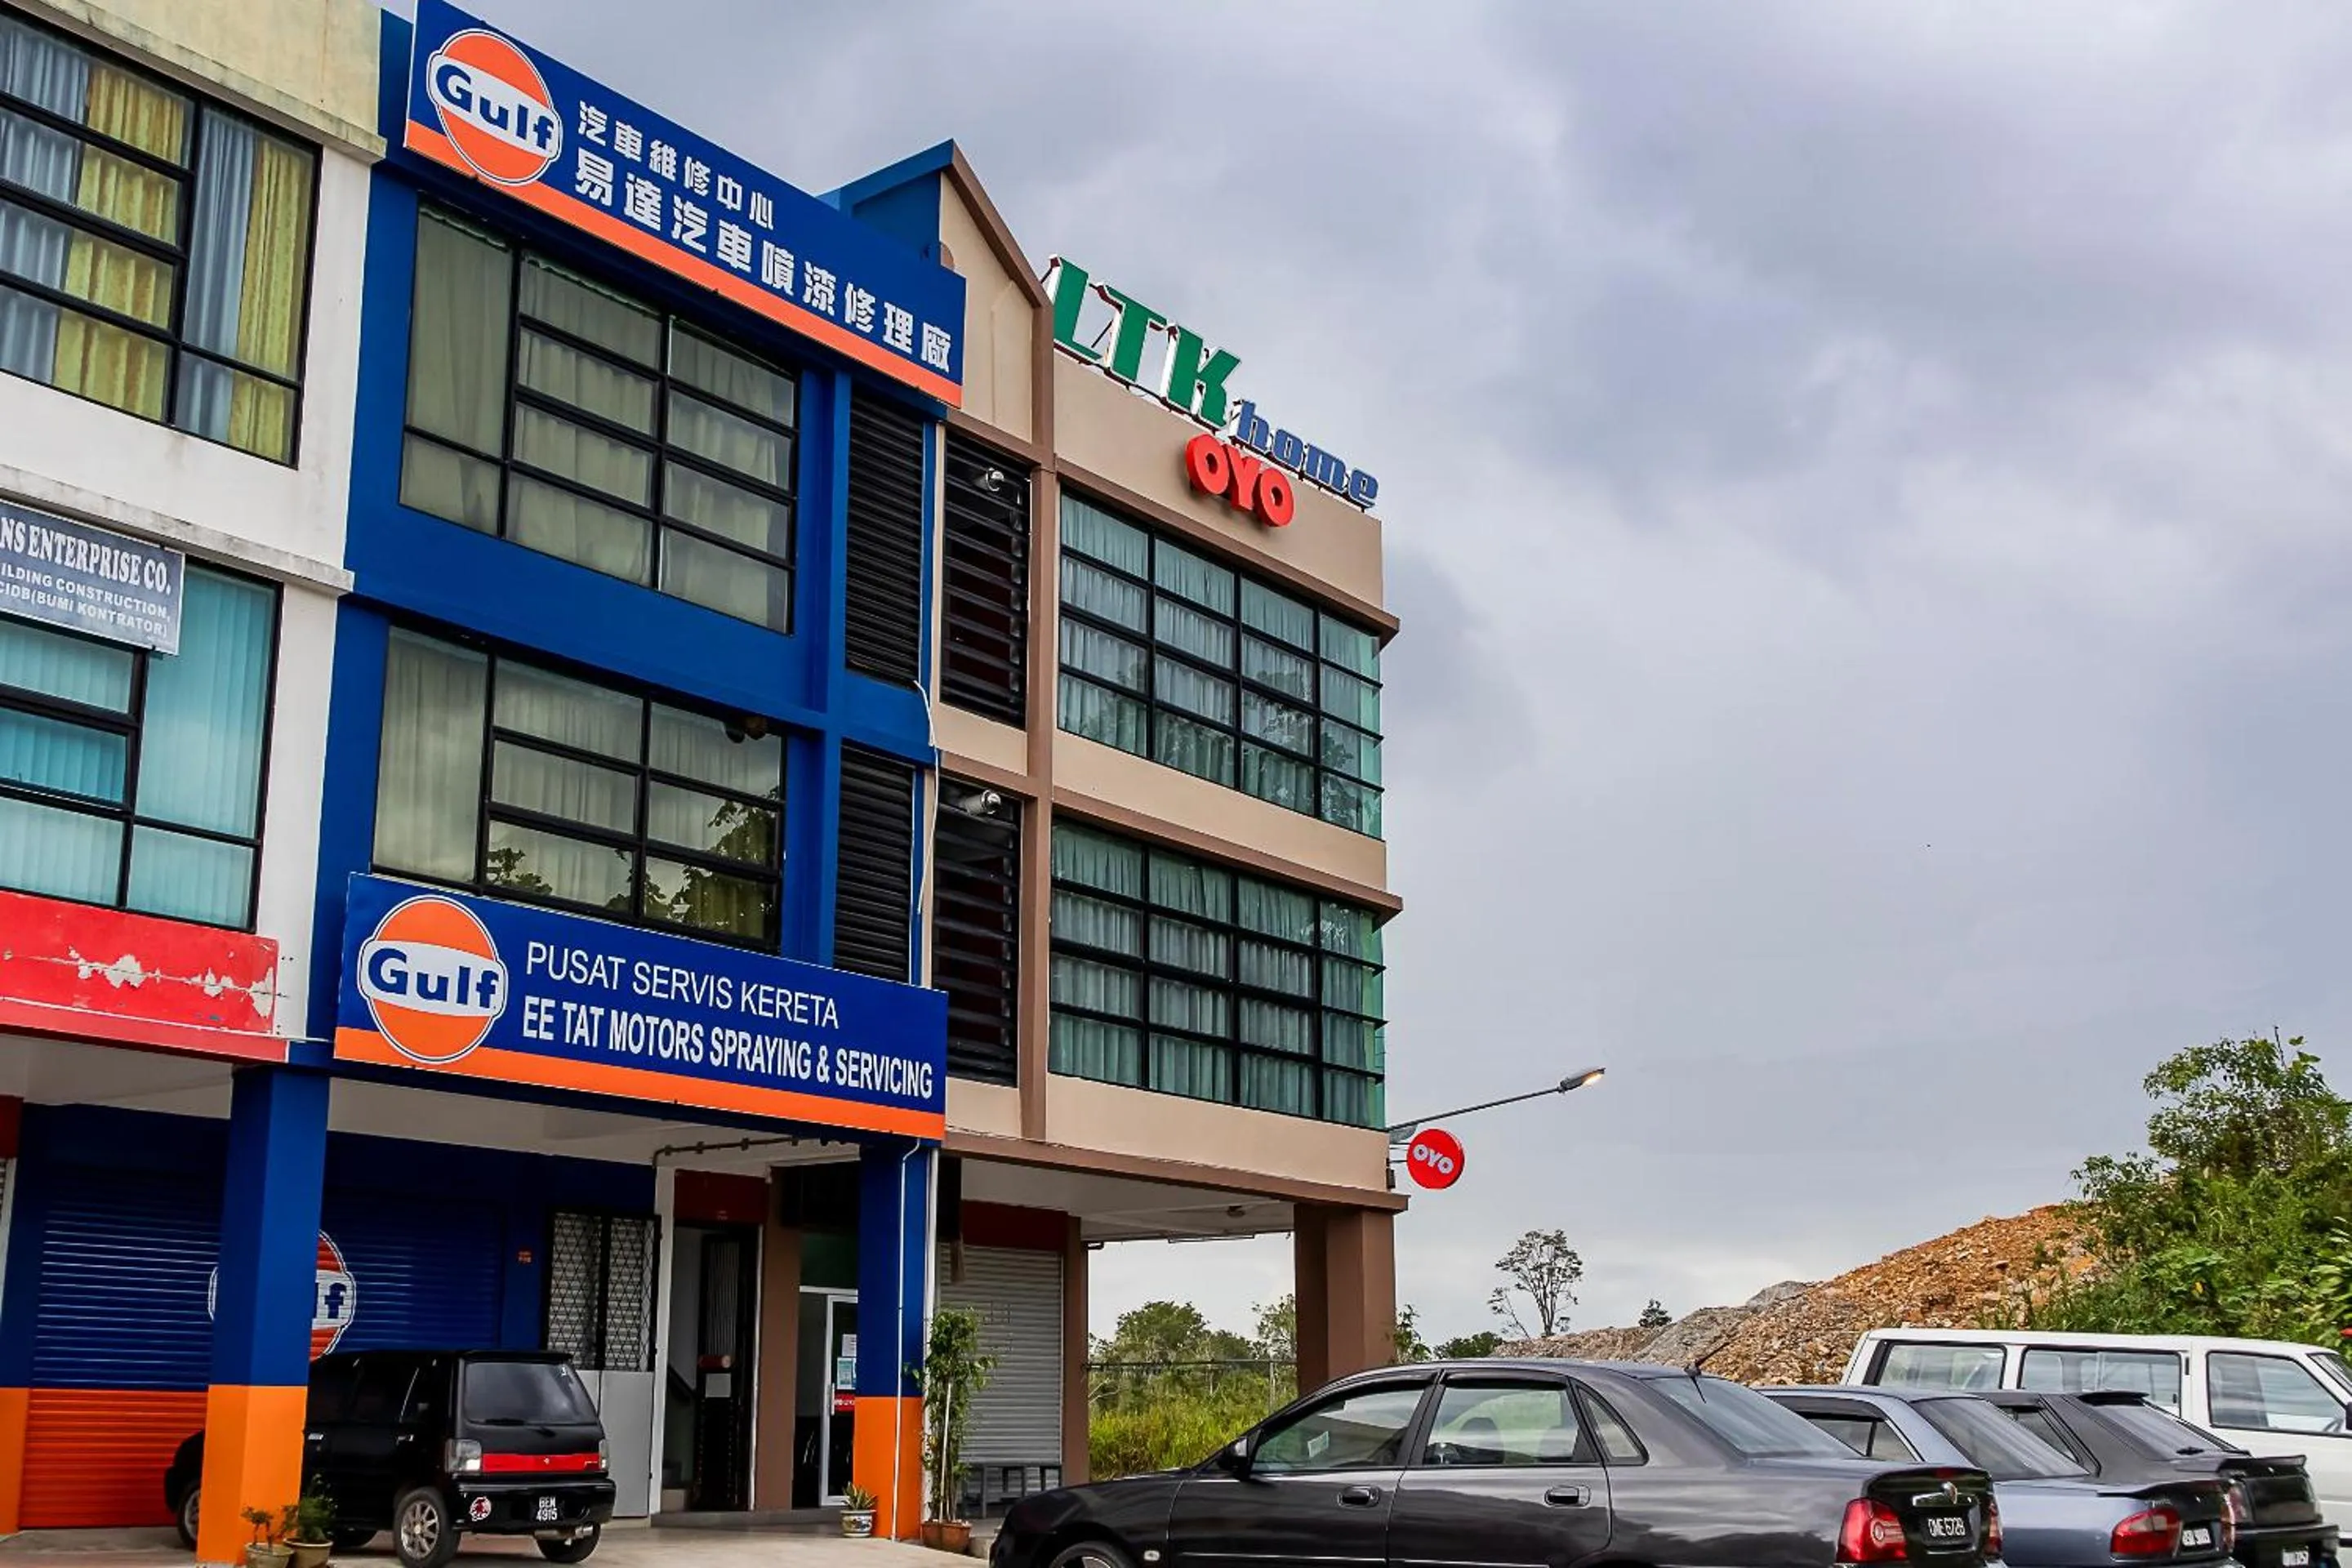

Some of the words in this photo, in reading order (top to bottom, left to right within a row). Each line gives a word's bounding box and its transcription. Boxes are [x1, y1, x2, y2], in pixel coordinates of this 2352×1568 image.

[436, 64, 555, 149] Gulf
[578, 100, 774, 230] 汽車維修中心
[575, 147, 951, 373] 易達汽車噴漆修理廠
[1047, 256, 1241, 429] LTK
[1232, 399, 1379, 509] home
[1185, 434, 1294, 528] OYO
[28, 525, 141, 586] ENTERPRISE
[368, 947, 500, 1009] Gulf
[527, 941, 626, 991] PUSAT
[632, 961, 733, 1010] SERVIS
[741, 981, 840, 1030] KERETA
[523, 995, 556, 1041] EE
[562, 1001, 604, 1048] TAT
[609, 1009, 704, 1064] MOTORS
[710, 1027, 811, 1080] SPRAYING
[816, 1045, 831, 1084] &
[835, 1049, 933, 1099] SERVICING
[1413, 1144, 1454, 1174] OYO
